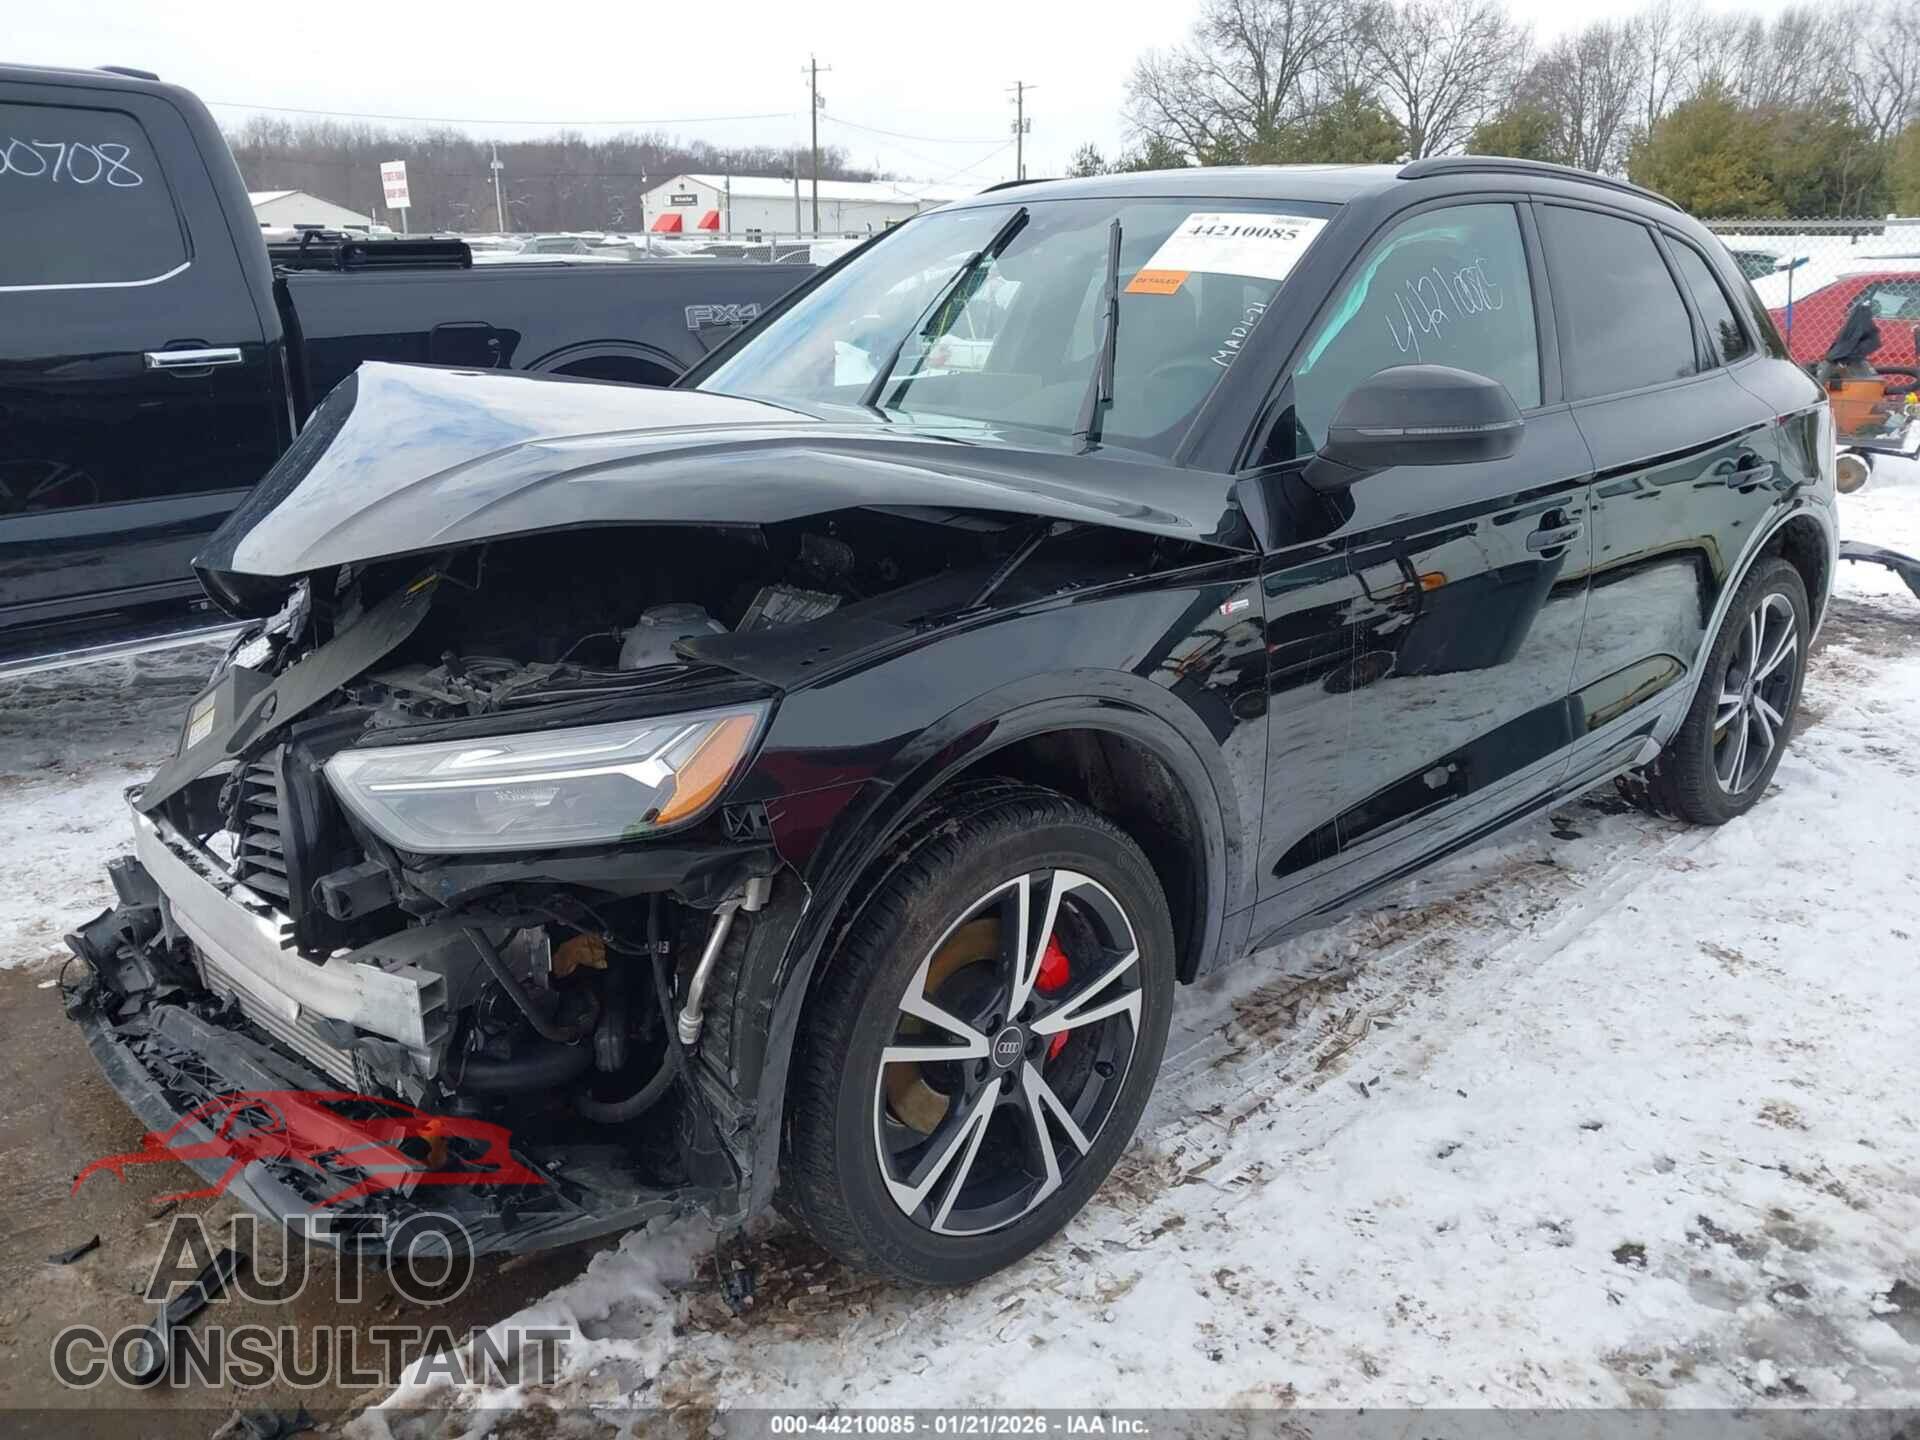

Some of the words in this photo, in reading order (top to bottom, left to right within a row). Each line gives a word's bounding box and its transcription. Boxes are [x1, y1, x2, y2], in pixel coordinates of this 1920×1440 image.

[0, 136, 143, 187] 0708
[1188, 224, 1300, 241] 44210085
[684, 303, 760, 331] FX4
